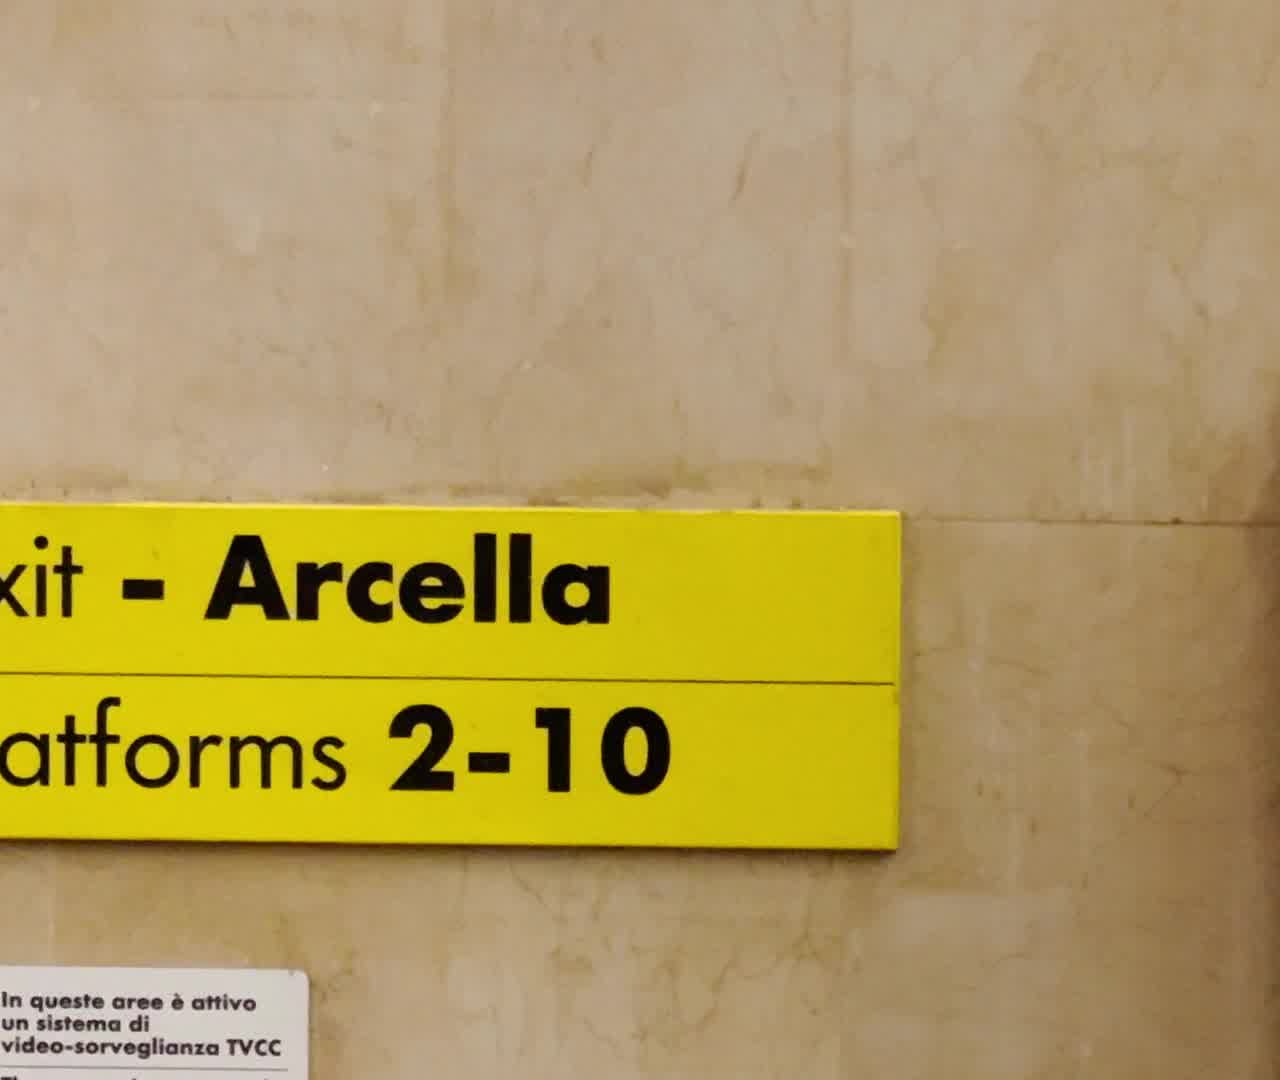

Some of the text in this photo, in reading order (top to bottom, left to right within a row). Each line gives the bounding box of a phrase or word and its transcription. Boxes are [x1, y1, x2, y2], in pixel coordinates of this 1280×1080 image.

[121, 578, 165, 601] -
[204, 532, 610, 626] Arcella
[388, 703, 672, 796] 2-10
[1, 991, 257, 1012] In queste aree è attivo
[1, 1014, 150, 1033] un sistema di
[1, 1036, 282, 1060] video-sorveglianza TVCC
